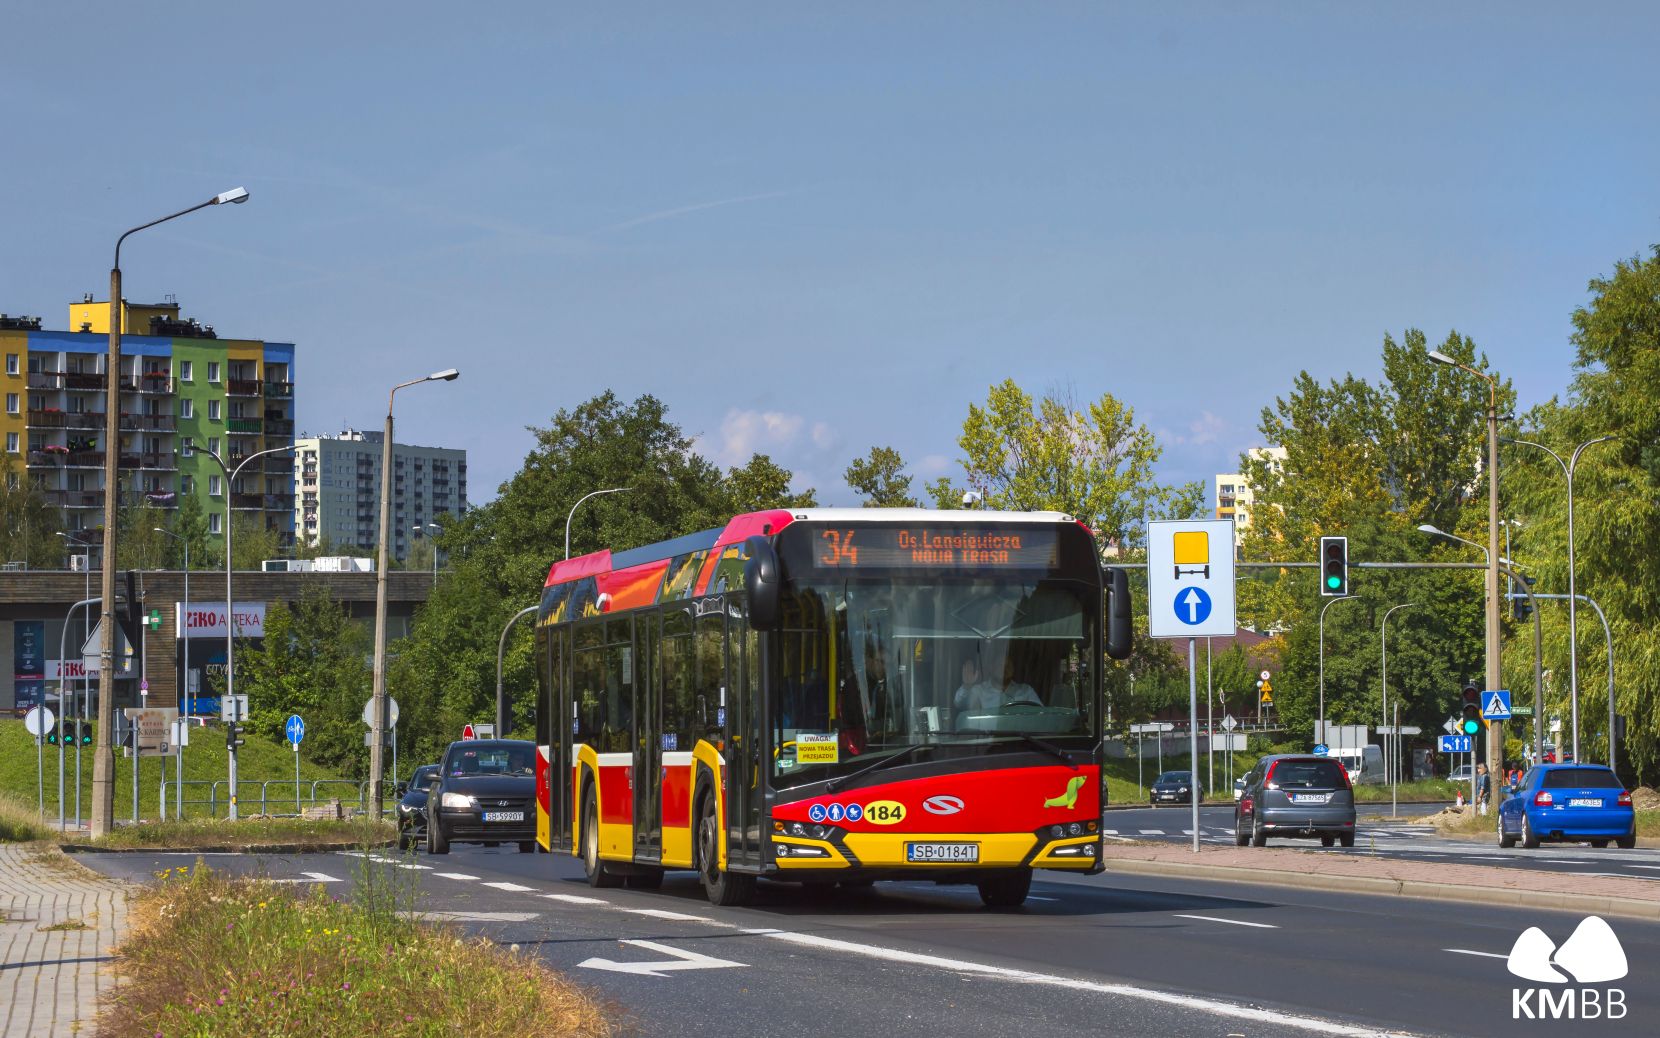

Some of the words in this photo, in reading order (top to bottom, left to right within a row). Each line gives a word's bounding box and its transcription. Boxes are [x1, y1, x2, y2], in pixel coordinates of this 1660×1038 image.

[821, 530, 858, 565] 34
[912, 550, 953, 564] NOWA
[961, 550, 1009, 564] TRASA
[218, 613, 261, 627] ATEKA
[804, 735, 831, 743] UWAGA!
[867, 805, 903, 821] 184
[915, 845, 934, 858] SB
[937, 845, 976, 858] 0184T
